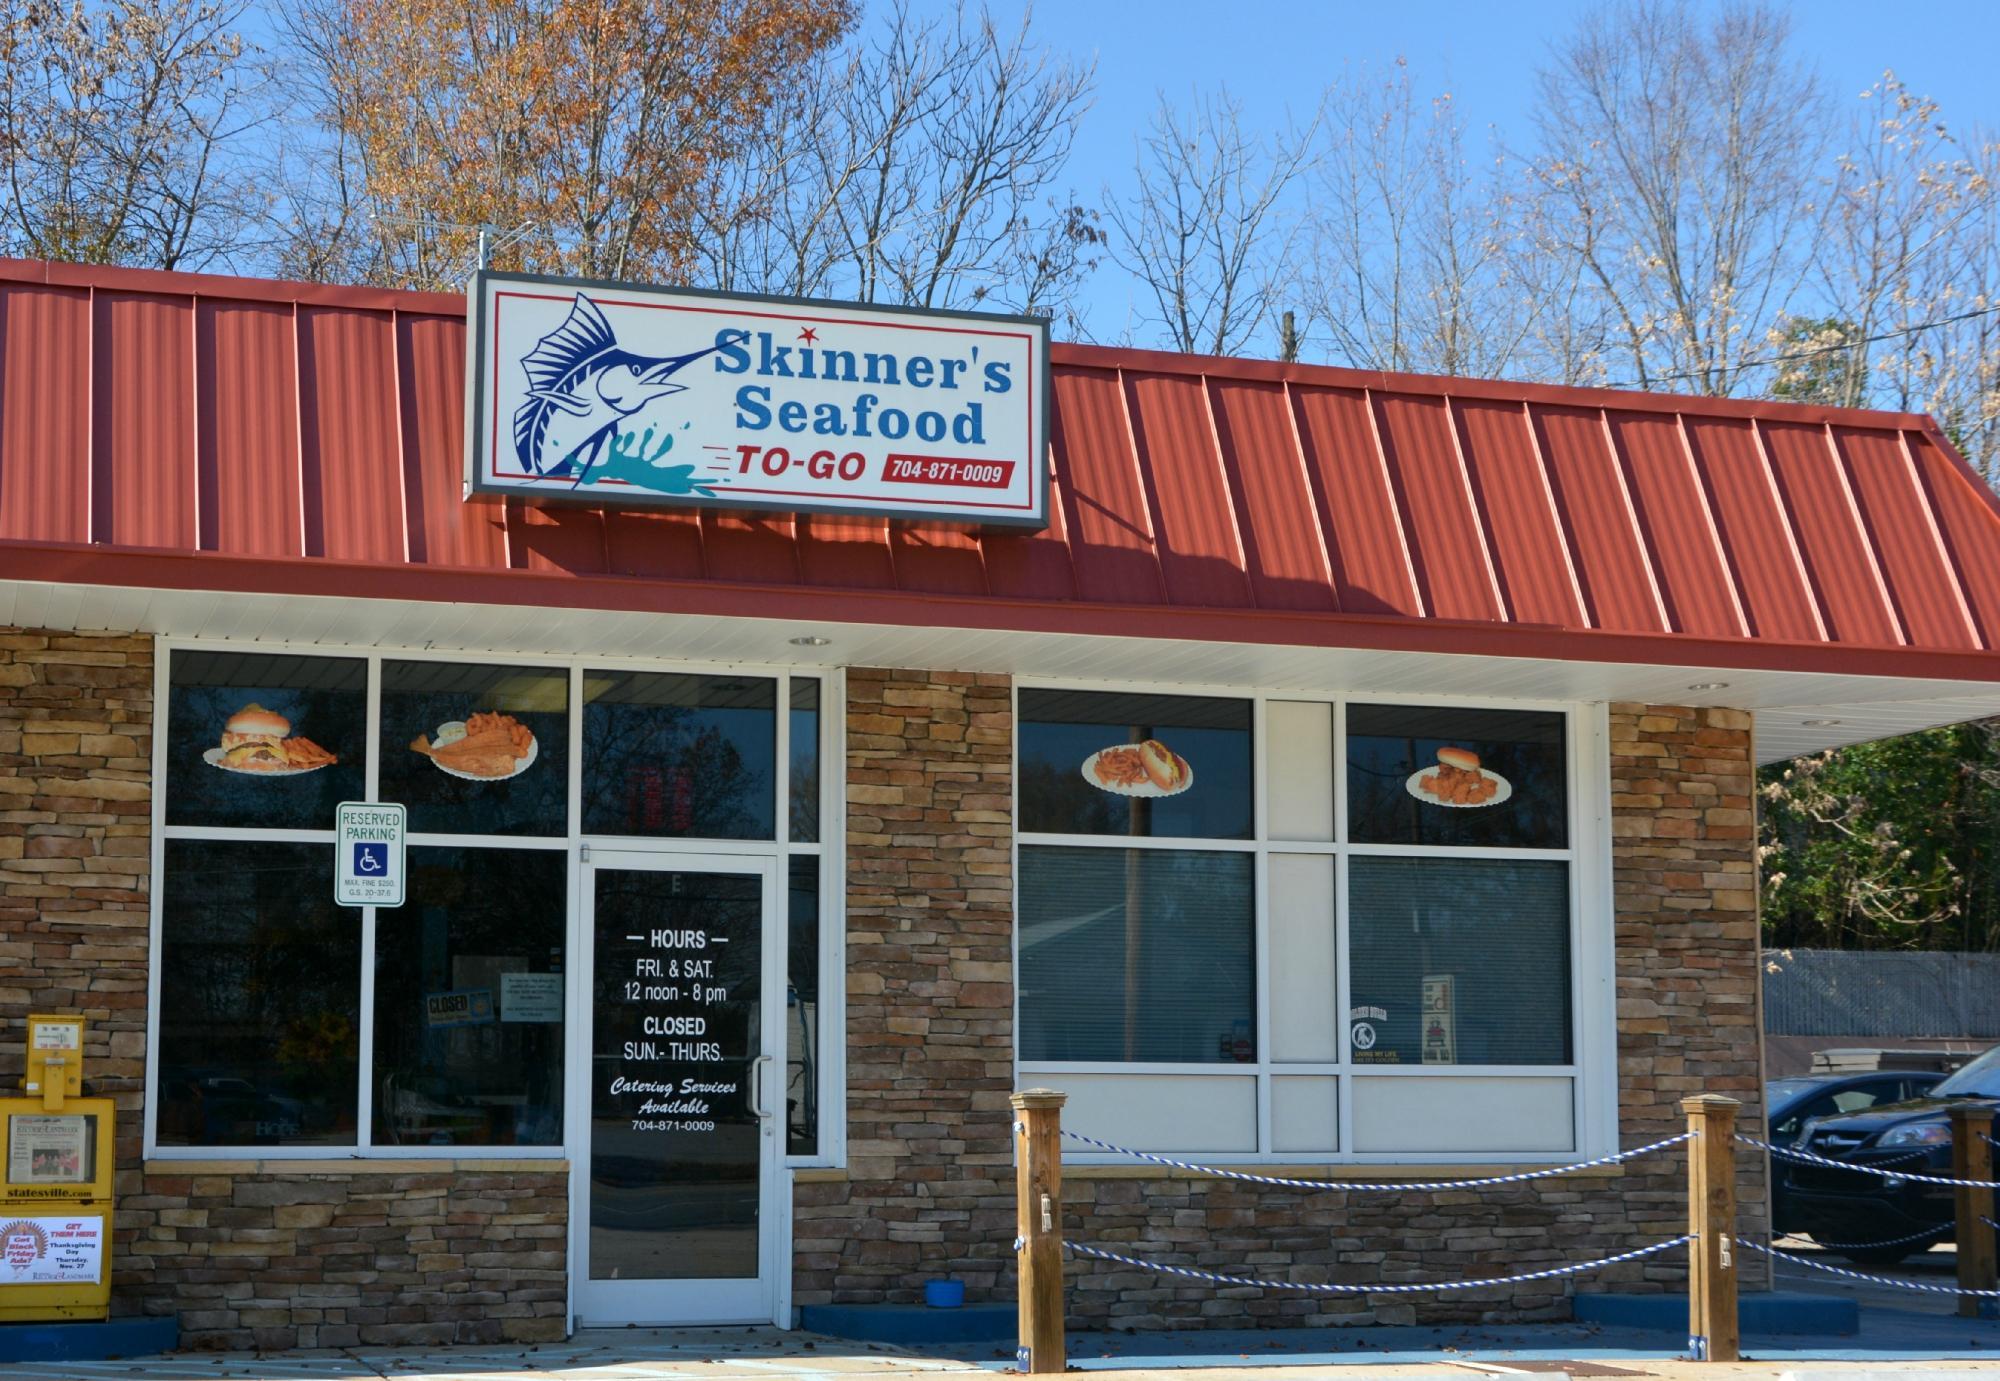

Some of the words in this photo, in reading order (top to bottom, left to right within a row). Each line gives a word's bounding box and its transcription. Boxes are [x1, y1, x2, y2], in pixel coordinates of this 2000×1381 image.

[714, 328, 1012, 394] Skinner's
[736, 385, 986, 445] Seafood
[735, 445, 866, 481] TO-GO
[891, 460, 1003, 484] 704-871-0009
[342, 812, 400, 826] RESERVED
[346, 828, 396, 841] PARKING
[651, 929, 706, 949] HOURS
[636, 959, 664, 978] FRI.
[668, 959, 679, 978] &
[683, 960, 714, 979] SAT.
[624, 982, 641, 1000] 12
[645, 985, 678, 1000] noon
[692, 983, 701, 1000] 8
[706, 987, 726, 1006] pm
[430, 995, 468, 1014] CLOSED
[643, 1017, 706, 1035] CLOSED
[669, 1042, 724, 1062] THURS.
[610, 1076, 673, 1098] Catering
[679, 1078, 737, 1095] Services
[638, 1098, 709, 1115] Available
[631, 1120, 715, 1131] 704-871-0009
[7, 1188, 92, 1198] statesville.com
